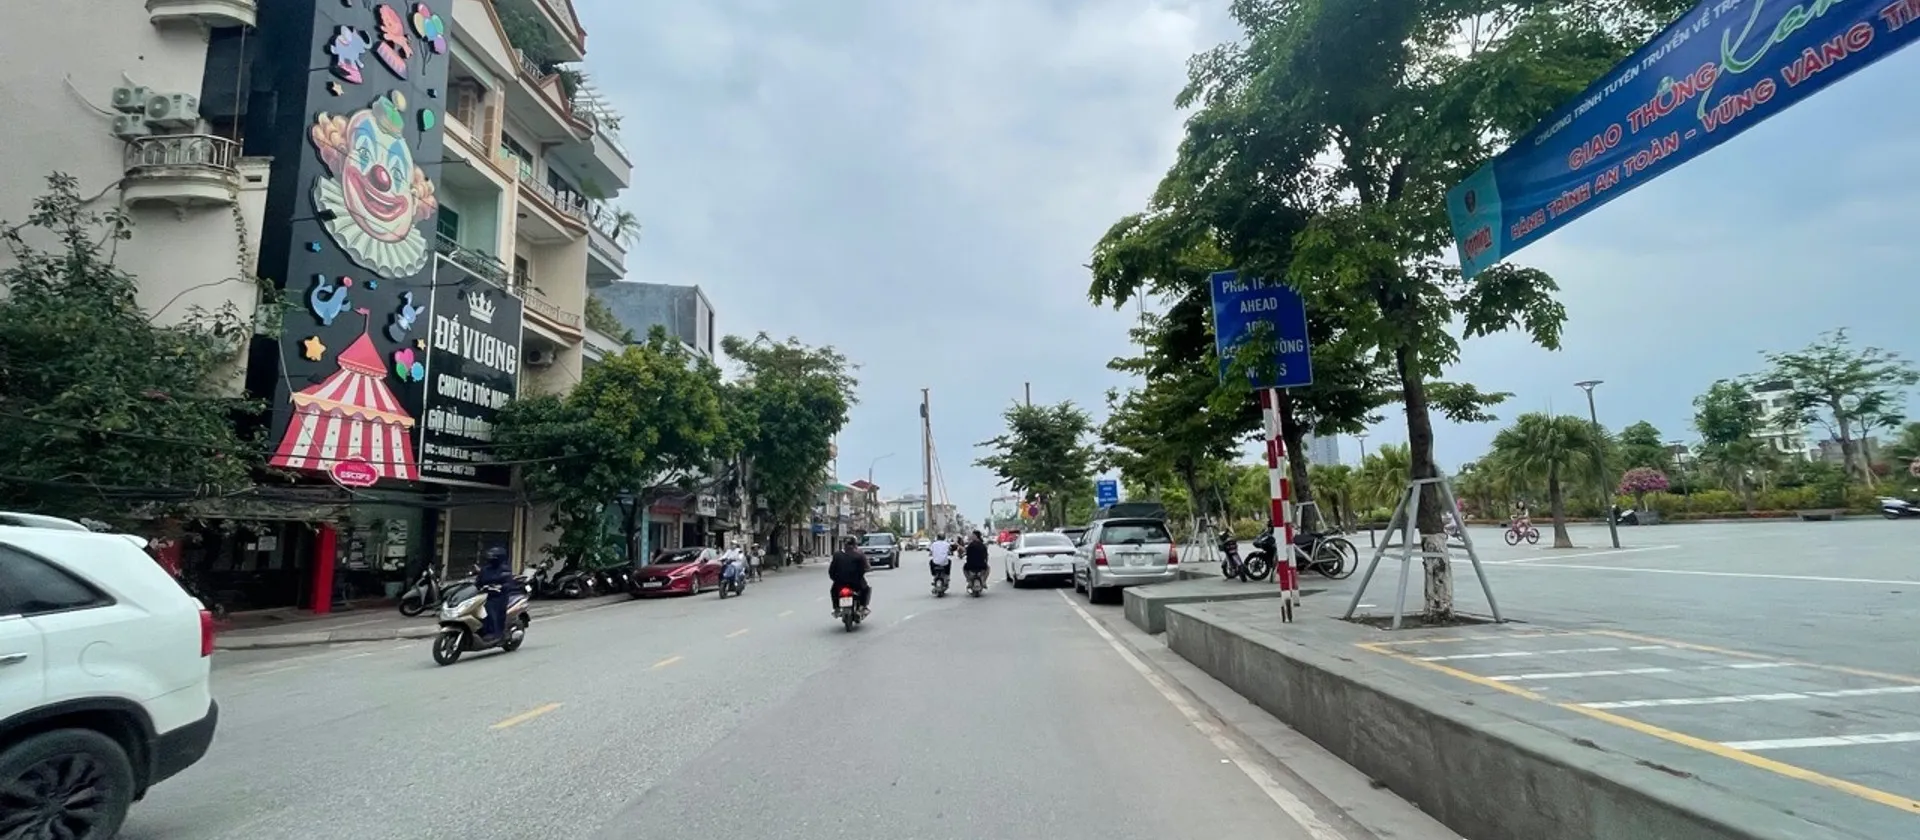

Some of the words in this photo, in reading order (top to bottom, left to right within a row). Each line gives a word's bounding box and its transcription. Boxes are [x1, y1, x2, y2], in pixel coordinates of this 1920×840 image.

[1510, 208, 1546, 241] HÀNH
[1546, 181, 1592, 220] TRÌNH
[1594, 164, 1620, 195] AN
[1623, 131, 1679, 178] TOÀN
[1701, 77, 1777, 133] VỮNG
[1780, 21, 1875, 88] VÀNG
[1568, 123, 1622, 171] GIAO
[1240, 296, 1278, 314] AHEAD
[434, 313, 461, 356] ĐẾ
[462, 324, 517, 375] VƯƠNG
